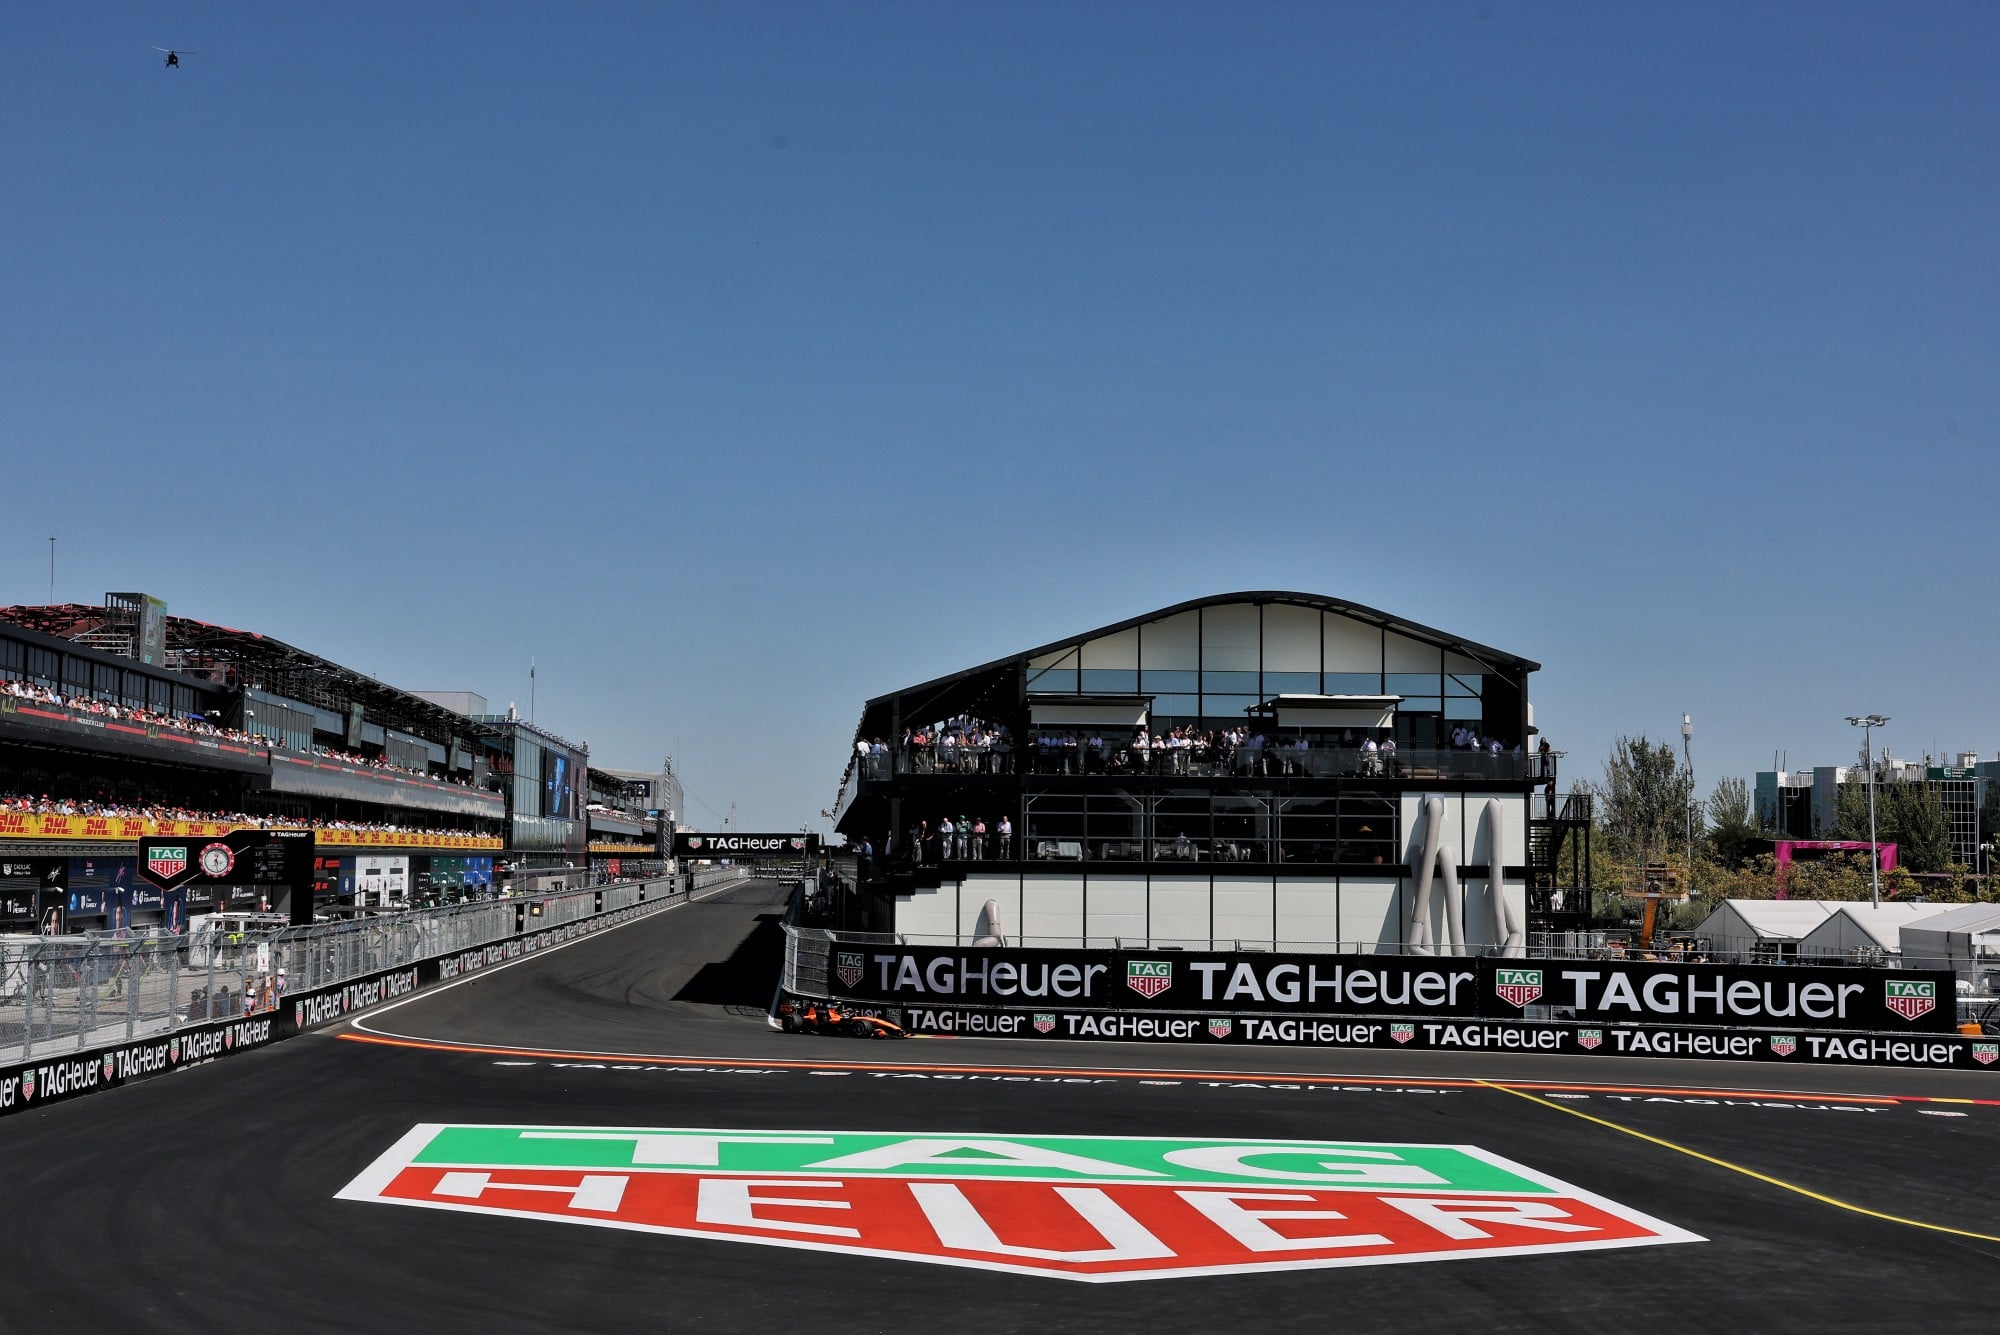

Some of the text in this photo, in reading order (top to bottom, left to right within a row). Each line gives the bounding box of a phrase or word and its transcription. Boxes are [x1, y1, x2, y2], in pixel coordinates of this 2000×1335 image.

[44, 817, 69, 834] DHL
[85, 819, 108, 835] DHL
[123, 821, 143, 836] DHL
[706, 837, 786, 850] TAGHeuer
[151, 849, 184, 859] TAG
[150, 861, 184, 876] HEUER
[839, 954, 862, 967] TAG
[1131, 963, 1168, 976] TAG
[838, 967, 862, 985] HEUER
[874, 955, 1107, 998] TAGHeuer
[1189, 962, 1475, 1006] TAGHeuer
[1500, 971, 1539, 985] TAG
[1129, 977, 1169, 996] HEUER
[1498, 986, 1540, 1005] HEUER
[1561, 970, 1865, 1018] TAGHeuer
[1889, 983, 1931, 996] TAG
[304, 991, 342, 1026] TAGHeuer
[1888, 998, 1933, 1018] HEUER
[907, 1009, 1025, 1033] TAGHeuer
[1063, 1014, 1200, 1038] TAGHeuer
[235, 1019, 271, 1048] TAGHeuer
[1240, 1019, 1382, 1044] TAGHeuer
[1423, 1024, 1569, 1049] TAGHeuer
[1580, 1030, 1600, 1038] TAG
[181, 1030, 224, 1062] TAGHeuer
[1611, 1030, 1762, 1056] TAGHeuer
[1805, 1036, 1963, 1064] TAGHeuer
[1974, 1044, 1996, 1052] TAG
[116, 1043, 168, 1079] TAGHeuer
[38, 1058, 101, 1098] TAGHeuer
[1606, 1095, 1890, 1113] TAGHeuer
[519, 1131, 1453, 1186] TAG
[431, 1172, 1604, 1262] HEUER
